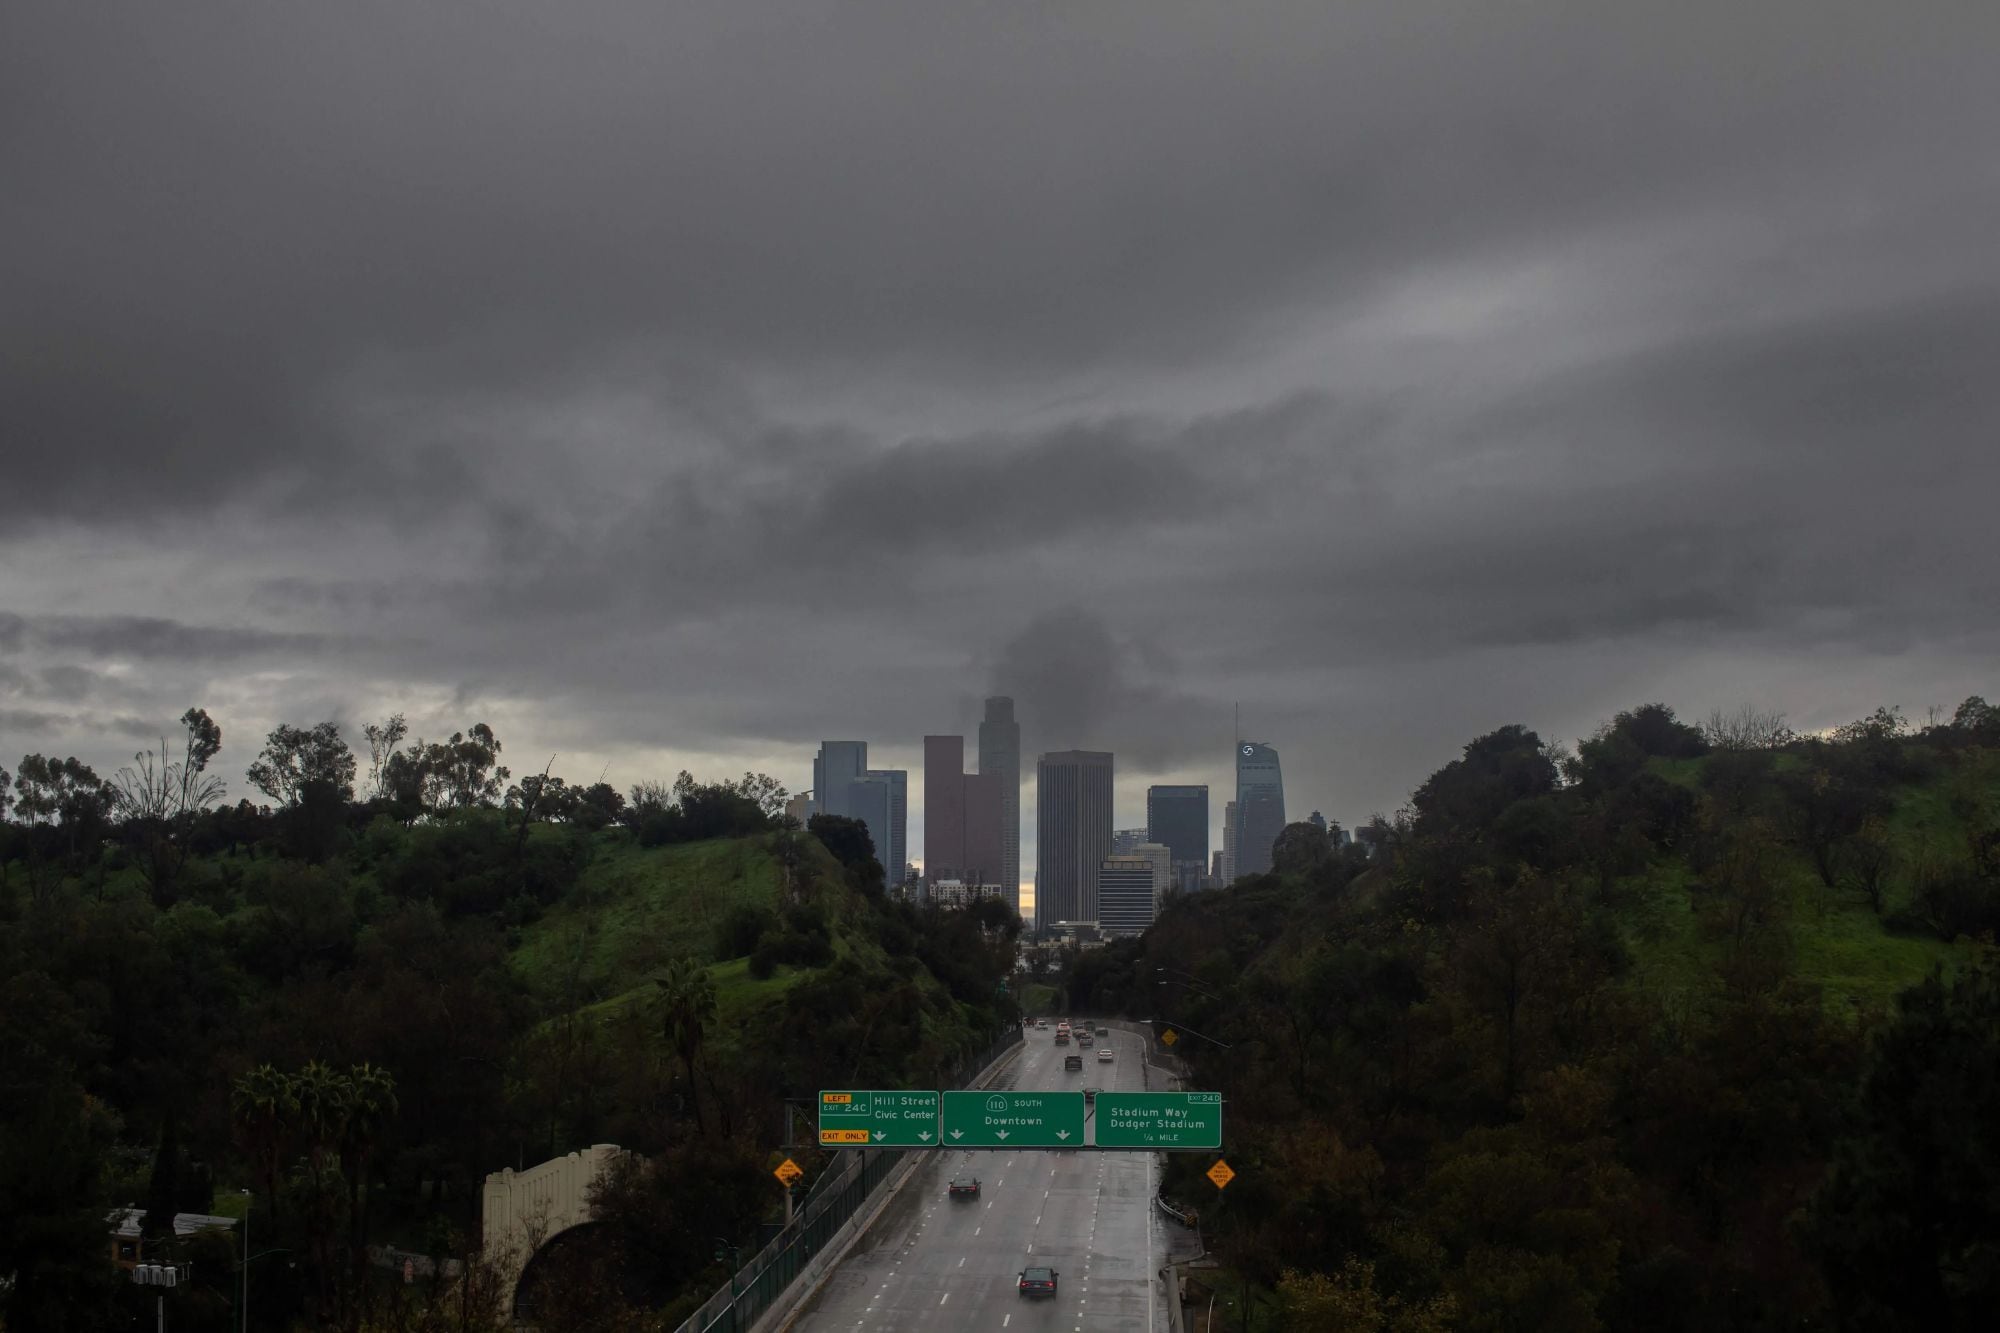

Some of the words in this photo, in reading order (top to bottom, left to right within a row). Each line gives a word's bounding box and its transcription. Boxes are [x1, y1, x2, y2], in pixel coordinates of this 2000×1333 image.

[874, 1096, 895, 1106] Hill
[900, 1096, 936, 1106] Street
[990, 1101, 1004, 1109] 110
[844, 1104, 867, 1112] 24C
[1111, 1107, 1159, 1116] Stadium
[1165, 1108, 1188, 1118] Way
[874, 1110, 898, 1119] Civic
[903, 1110, 935, 1119] Center
[985, 1116, 1042, 1125] Downtown
[1110, 1119, 1151, 1130] Dodger
[1157, 1119, 1205, 1128] Stadium
